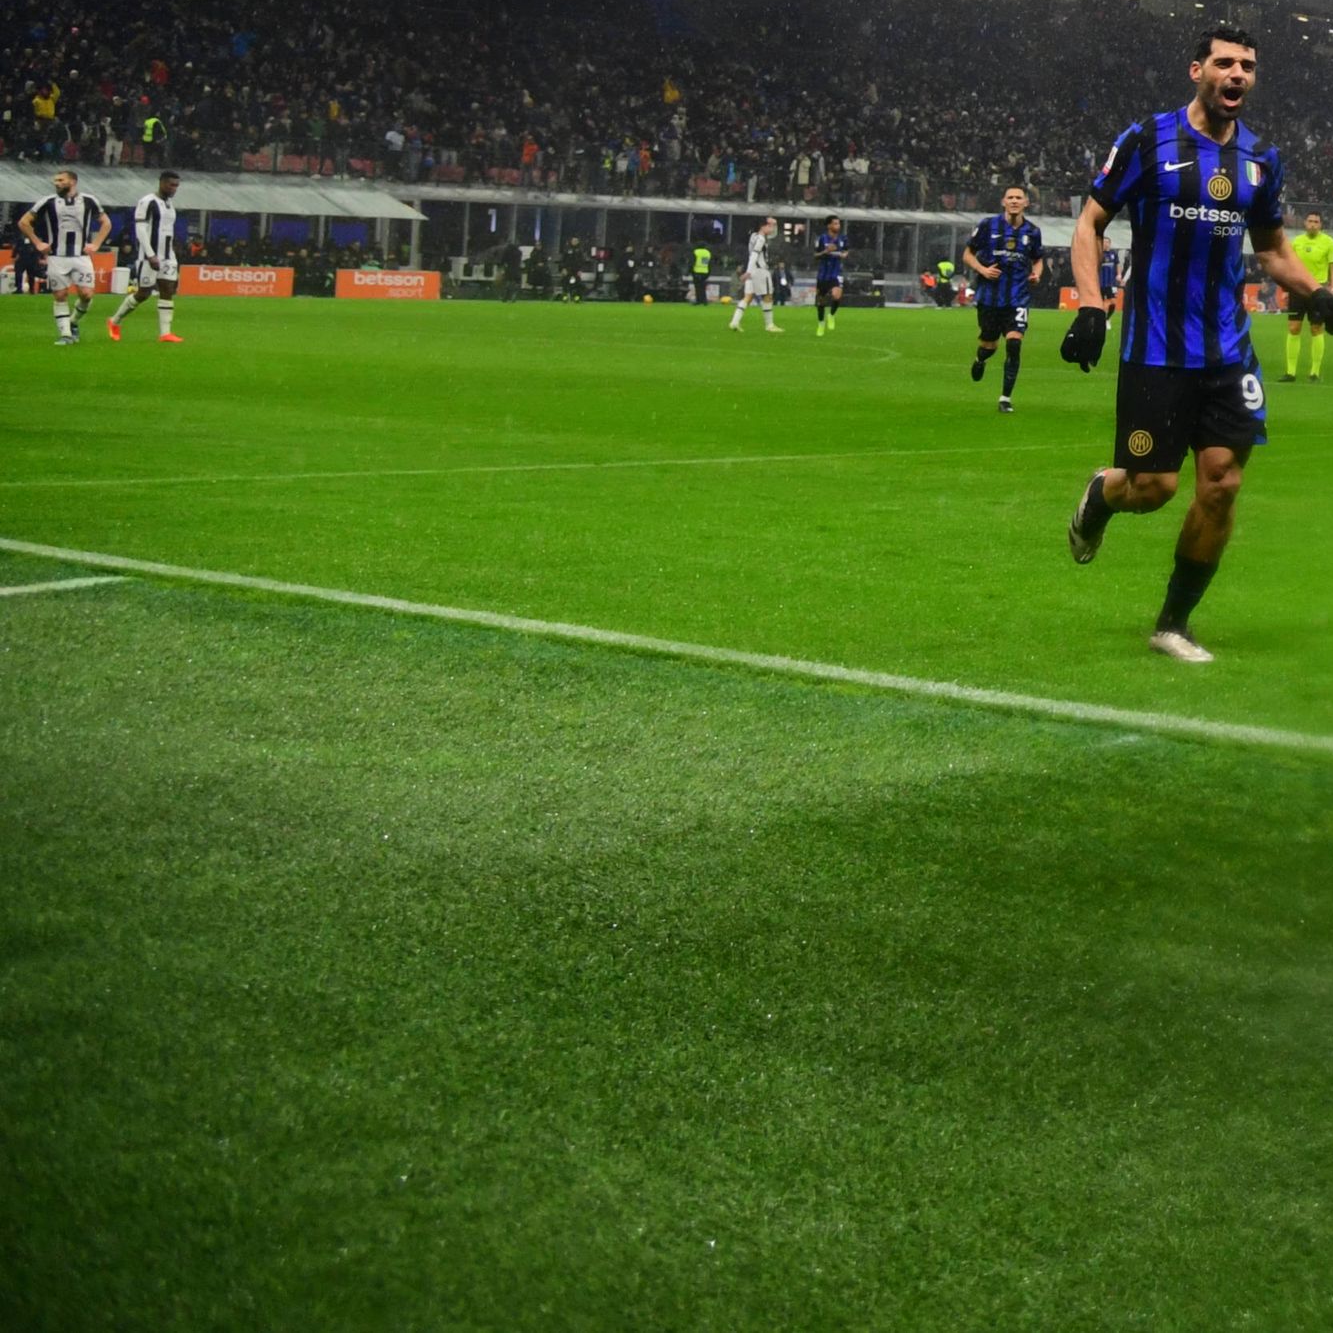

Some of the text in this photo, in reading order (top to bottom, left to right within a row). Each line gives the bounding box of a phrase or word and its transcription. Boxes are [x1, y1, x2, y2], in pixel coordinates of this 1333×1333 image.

[1169, 202, 1246, 224] betsson
[79, 271, 93, 284] 25
[199, 267, 277, 283] betsson
[353, 271, 425, 287] betsson
[1015, 307, 1028, 322] 21
